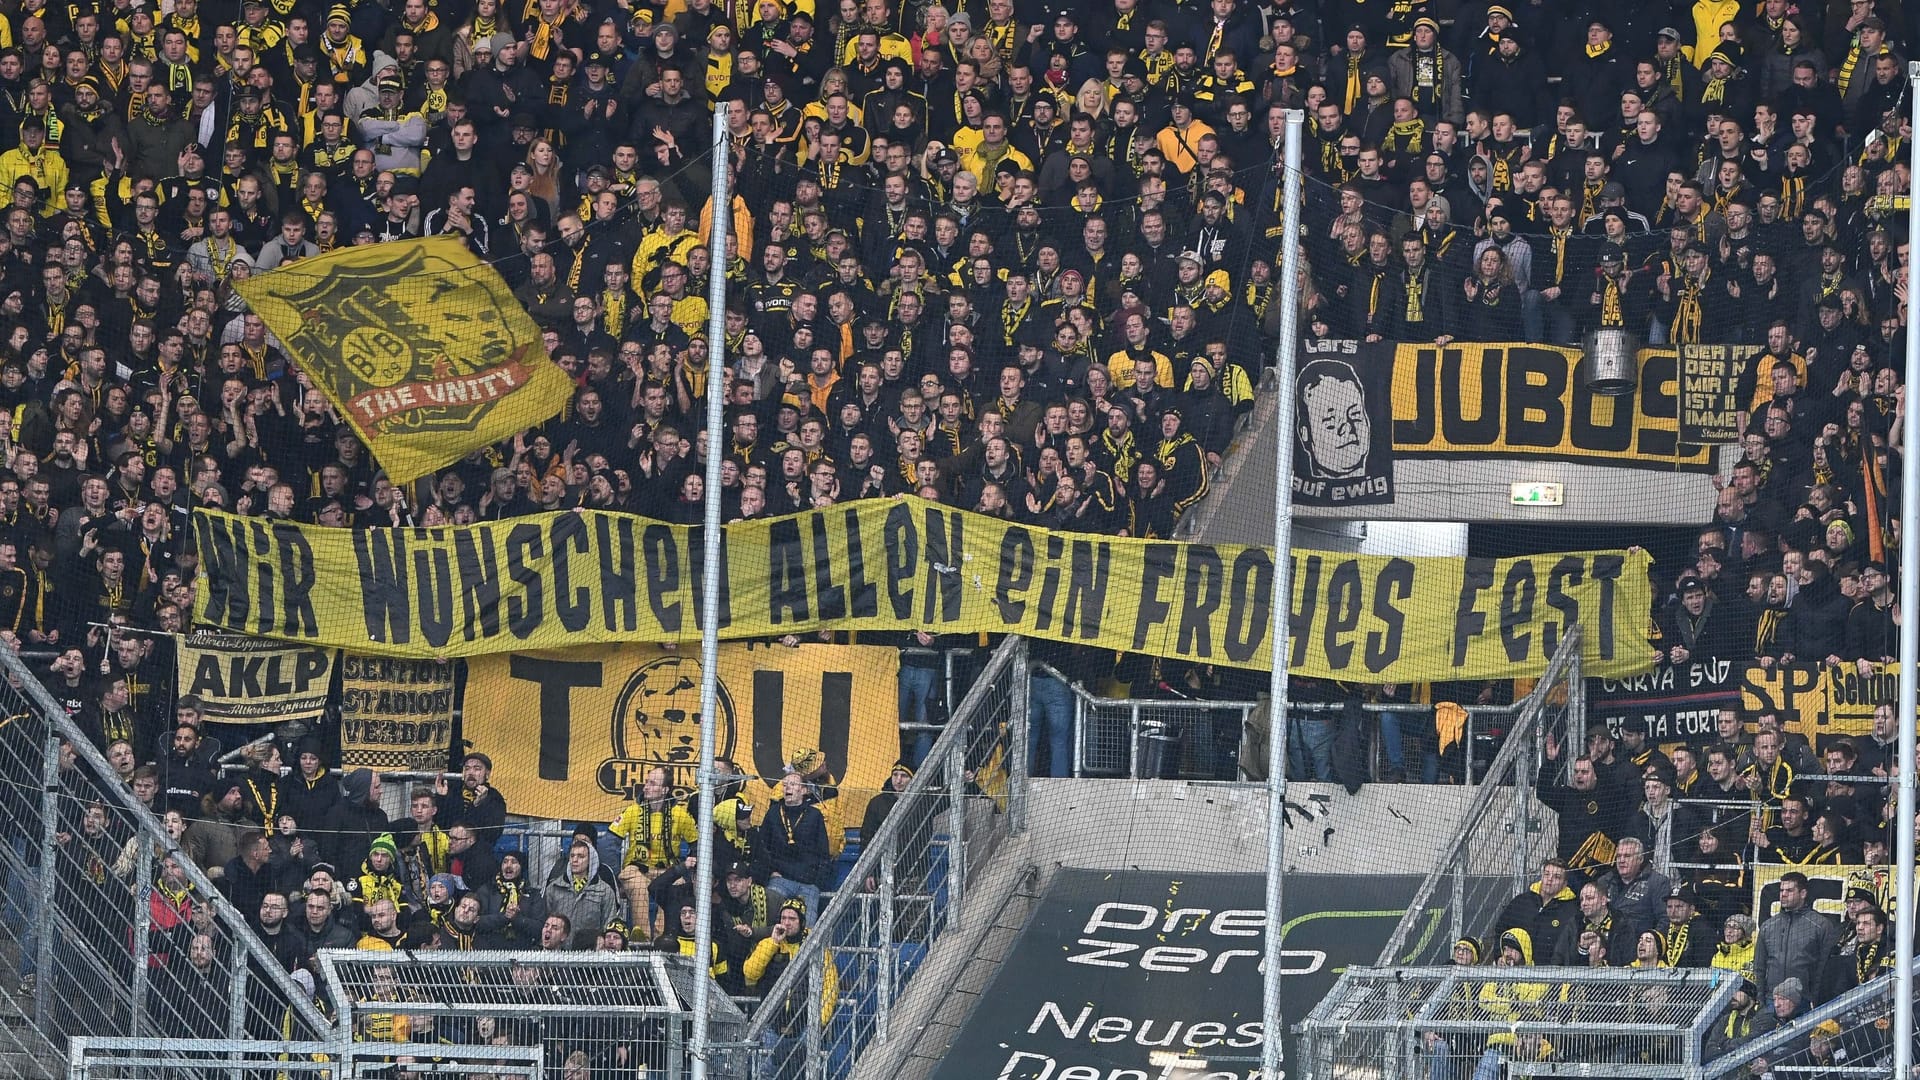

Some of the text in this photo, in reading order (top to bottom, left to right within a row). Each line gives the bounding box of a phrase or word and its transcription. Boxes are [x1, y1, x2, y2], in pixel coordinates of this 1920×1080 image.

[348, 331, 404, 379] BVB
[1304, 338, 1358, 354] Lars
[1685, 345, 1725, 360] DER
[382, 361, 402, 379] 09
[1685, 360, 1725, 376] DER
[355, 367, 516, 419] THE UNITY
[1685, 376, 1721, 393] MIR
[1685, 393, 1717, 409] IST
[1332, 475, 1388, 500] ewig
[189, 649, 328, 698] AKLP
[343, 687, 452, 716] STADION
[342, 719, 450, 746] VERBOT
[1082, 902, 1268, 937] pre
[1065, 938, 1328, 975] zero
[1026, 1001, 1266, 1048] Neues
